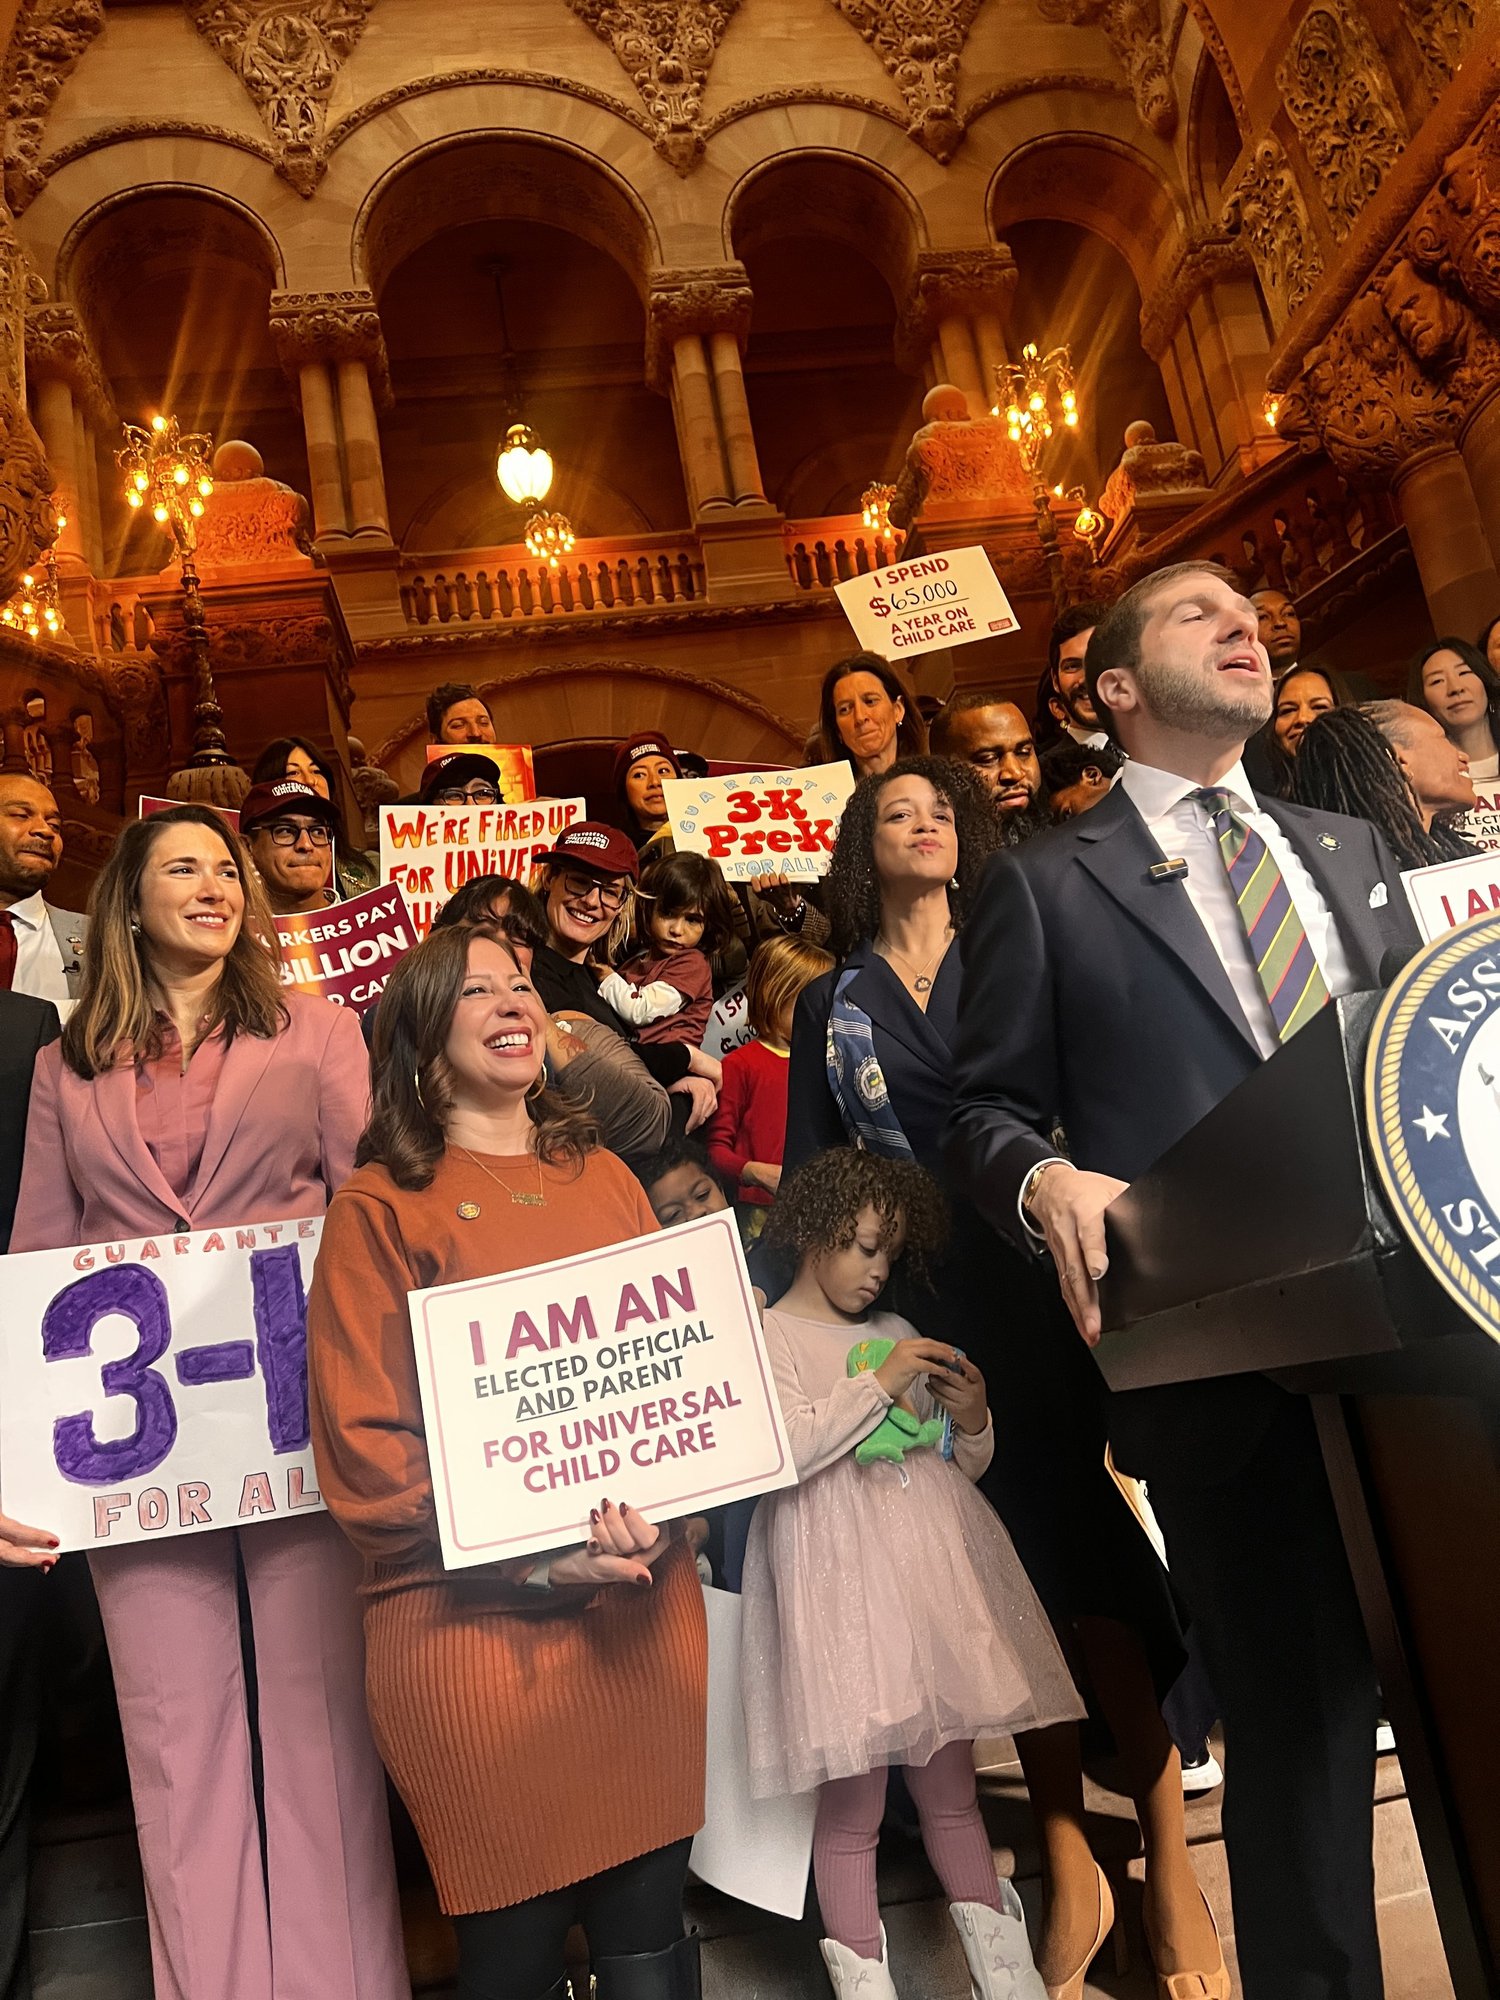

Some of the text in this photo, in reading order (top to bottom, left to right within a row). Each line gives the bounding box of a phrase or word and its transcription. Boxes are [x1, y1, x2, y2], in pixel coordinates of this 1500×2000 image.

[873, 558, 950, 589] I SPEND
[869, 580, 958, 618] $65,000
[891, 606, 969, 635] A YEAR ON
[892, 629, 934, 647] CHILD
[938, 618, 976, 637] CARE
[727, 788, 808, 823] 3-K
[386, 810, 470, 849] WE'RE
[549, 804, 578, 836] UP
[703, 819, 835, 857] Pre-K
[1472, 839, 1500, 850] OR
[389, 863, 434, 894] FOR
[734, 857, 818, 876] FOR ALL
[355, 898, 397, 928] PAY
[1441, 895, 1456, 927] I
[279, 925, 410, 986] BILLION
[469, 1266, 696, 1366] I AM AN
[474, 1320, 714, 1399] ELECTED OFFICIAL
[515, 1355, 684, 1421] AND PARENT
[483, 1380, 742, 1468] FOR UNIVERSAL
[523, 1421, 717, 1493] CHILD CARE
[93, 1482, 212, 1538] FOR
